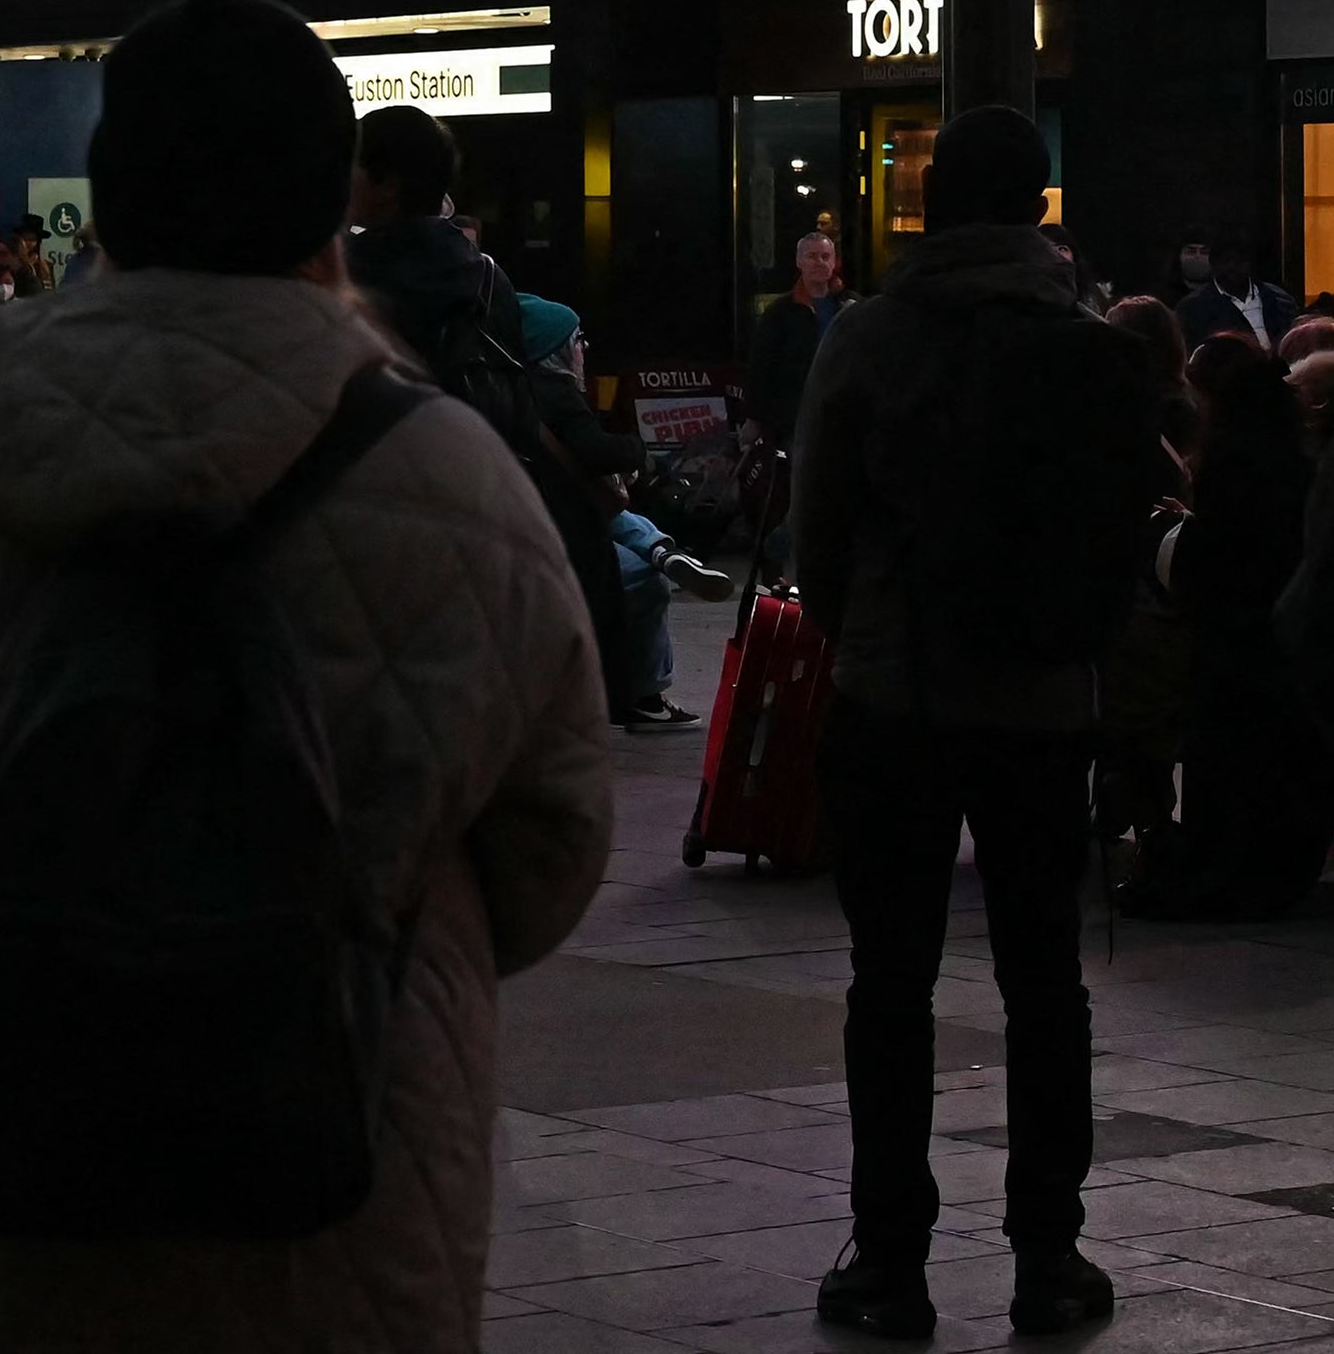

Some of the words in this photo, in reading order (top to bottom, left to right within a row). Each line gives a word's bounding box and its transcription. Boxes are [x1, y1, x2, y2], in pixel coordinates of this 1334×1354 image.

[345, 74, 403, 101] Euston
[410, 68, 473, 99] Station
[638, 371, 712, 388] TORTILLA
